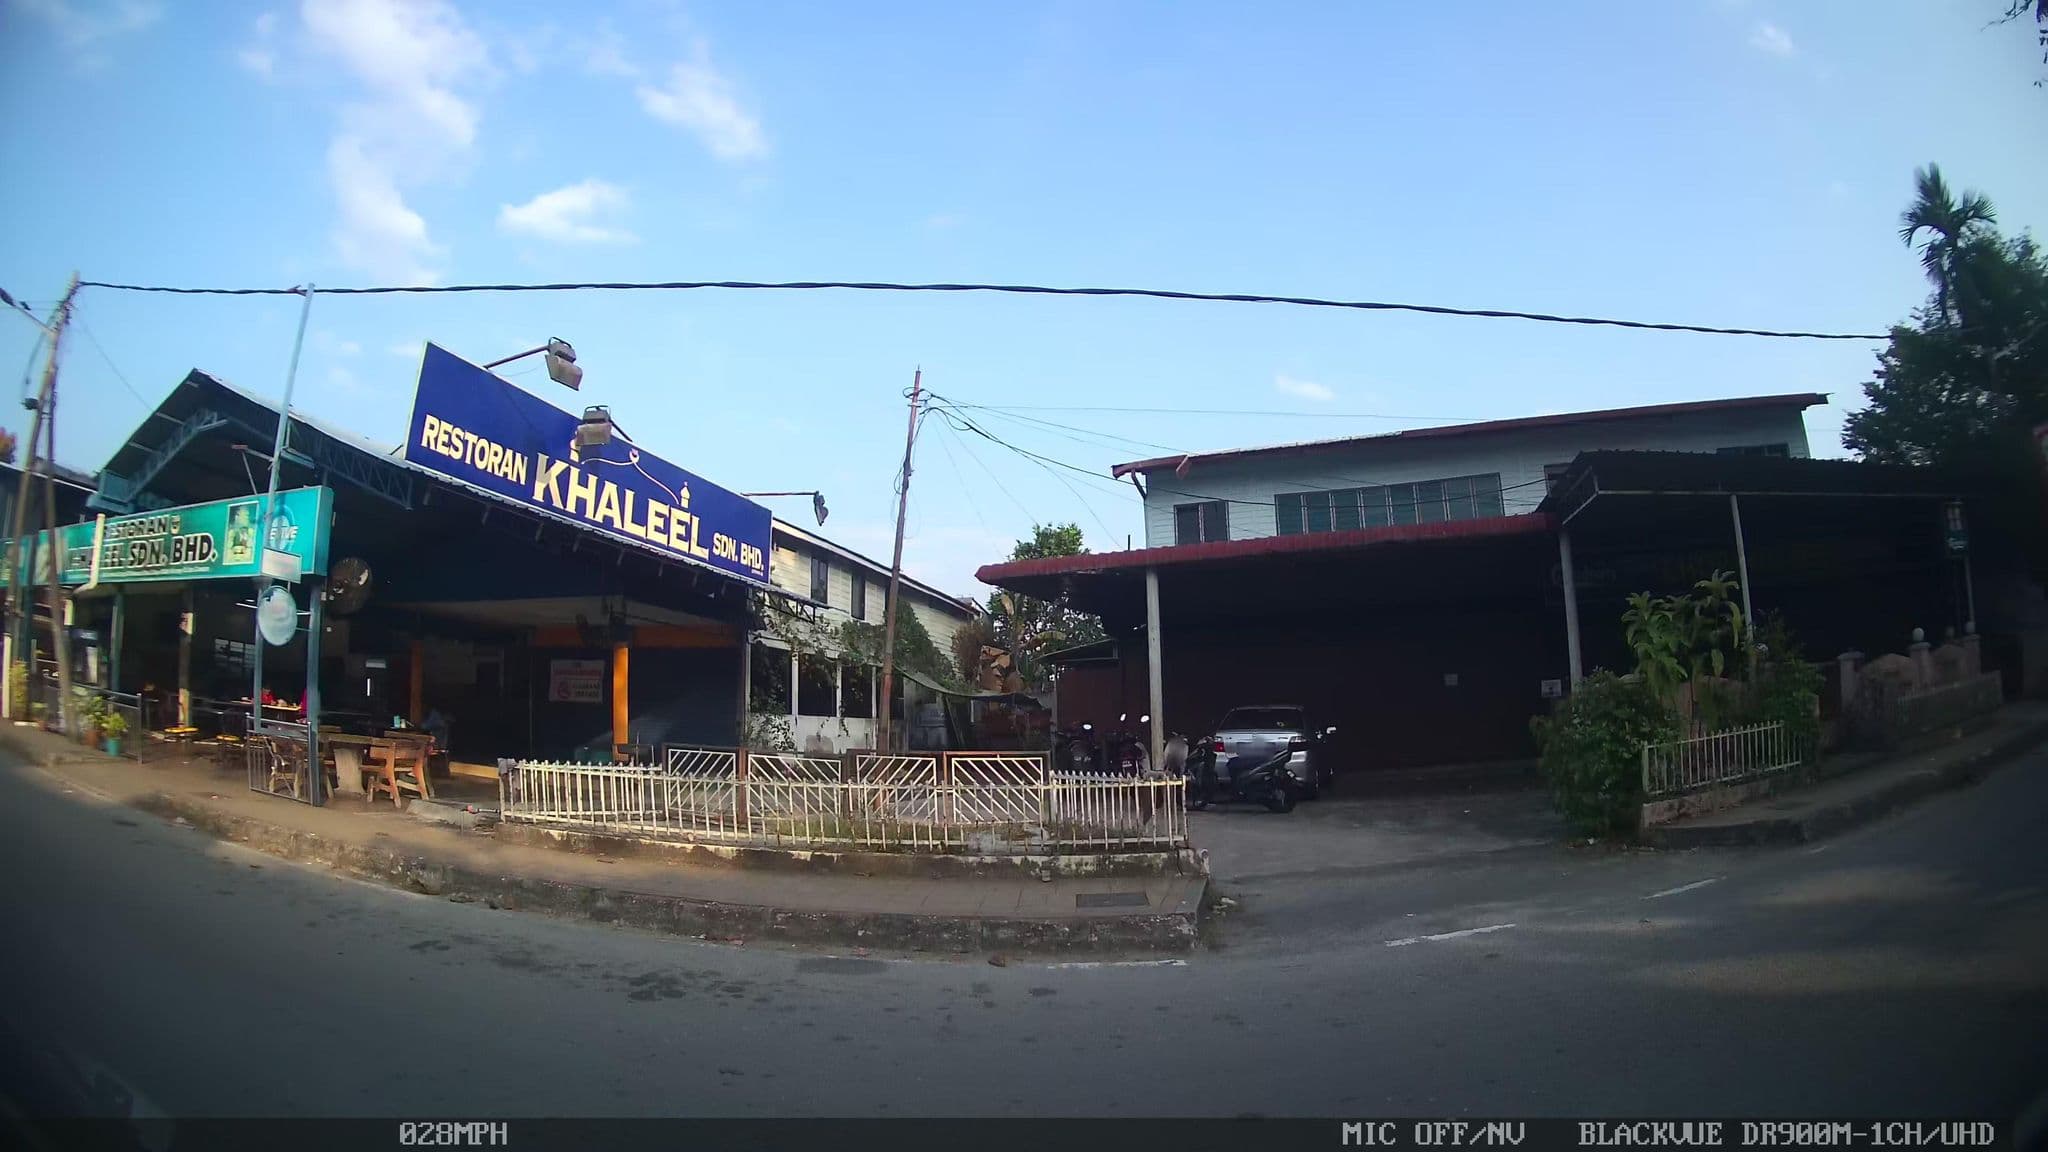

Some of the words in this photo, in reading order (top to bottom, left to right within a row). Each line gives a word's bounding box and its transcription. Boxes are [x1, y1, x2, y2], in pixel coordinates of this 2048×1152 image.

[421, 414, 528, 486] RESTORAN
[532, 452, 709, 561] KHALEEL
[713, 532, 739, 563] SDN.
[740, 542, 765, 572] BHD.
[127, 537, 168, 568] SDN.
[170, 532, 218, 565] BHD.
